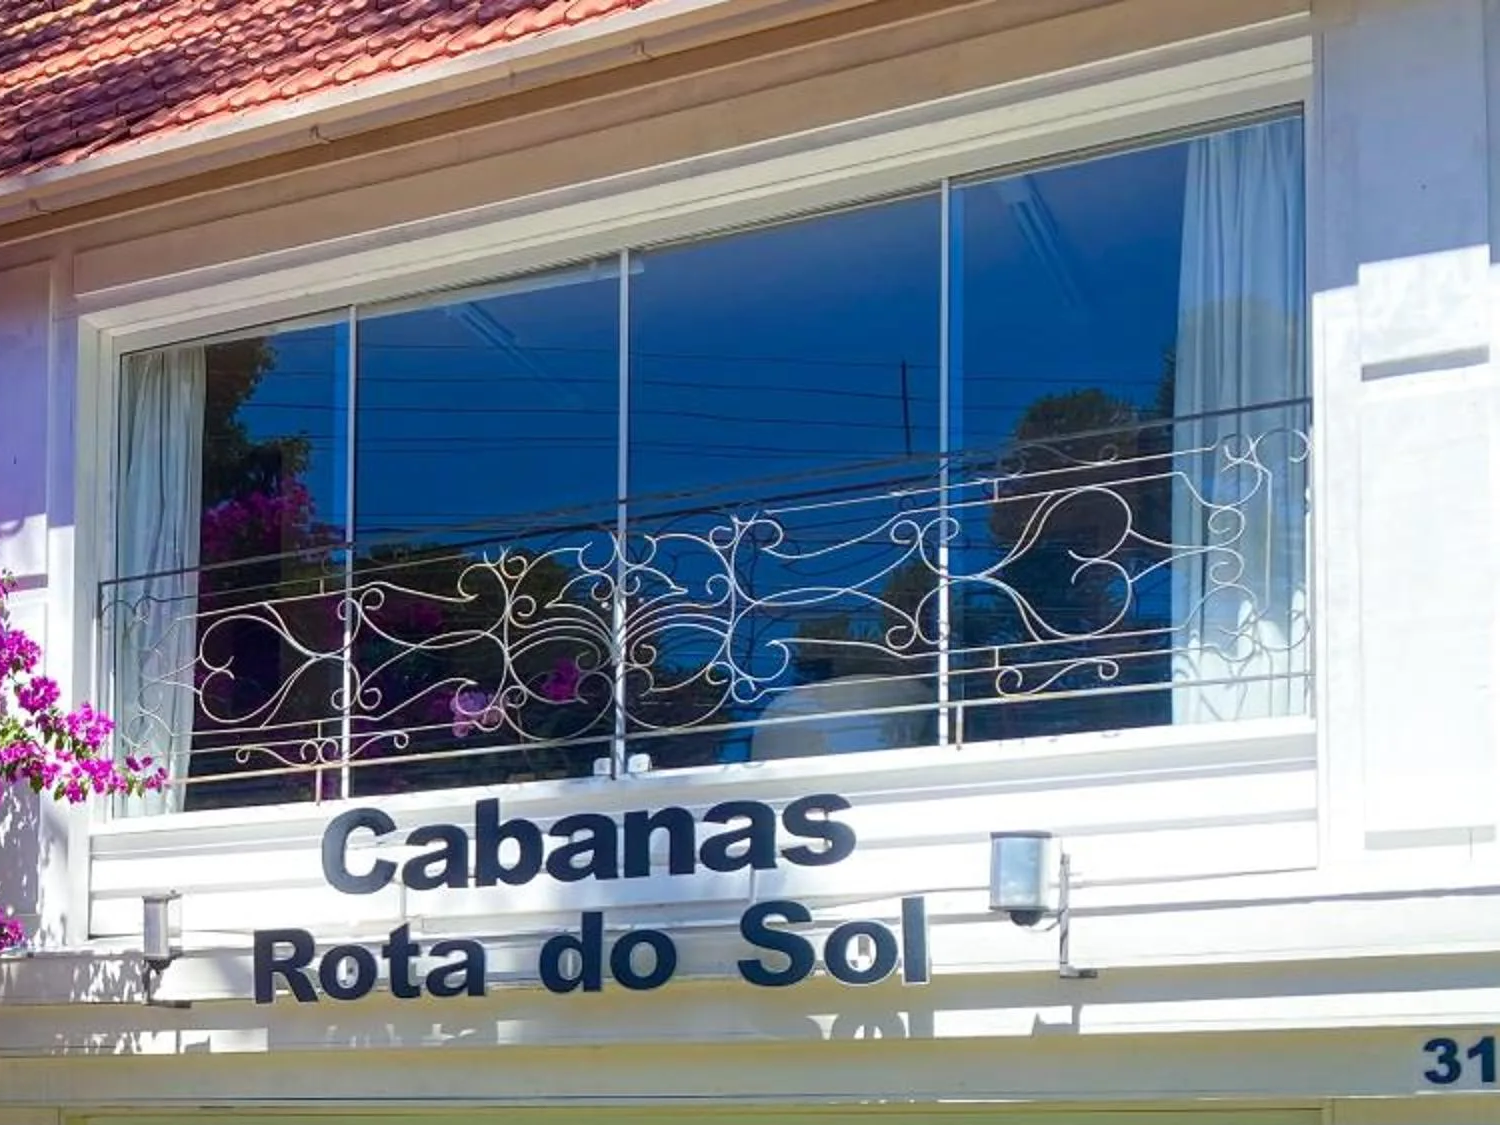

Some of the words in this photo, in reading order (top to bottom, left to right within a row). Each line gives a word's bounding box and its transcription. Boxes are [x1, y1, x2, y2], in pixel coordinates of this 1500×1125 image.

[320, 793, 857, 895] Cabanas
[253, 921, 487, 1003] Rota
[539, 911, 677, 993] do
[737, 898, 930, 987] Sol
[1423, 1036, 1496, 1084] 31
